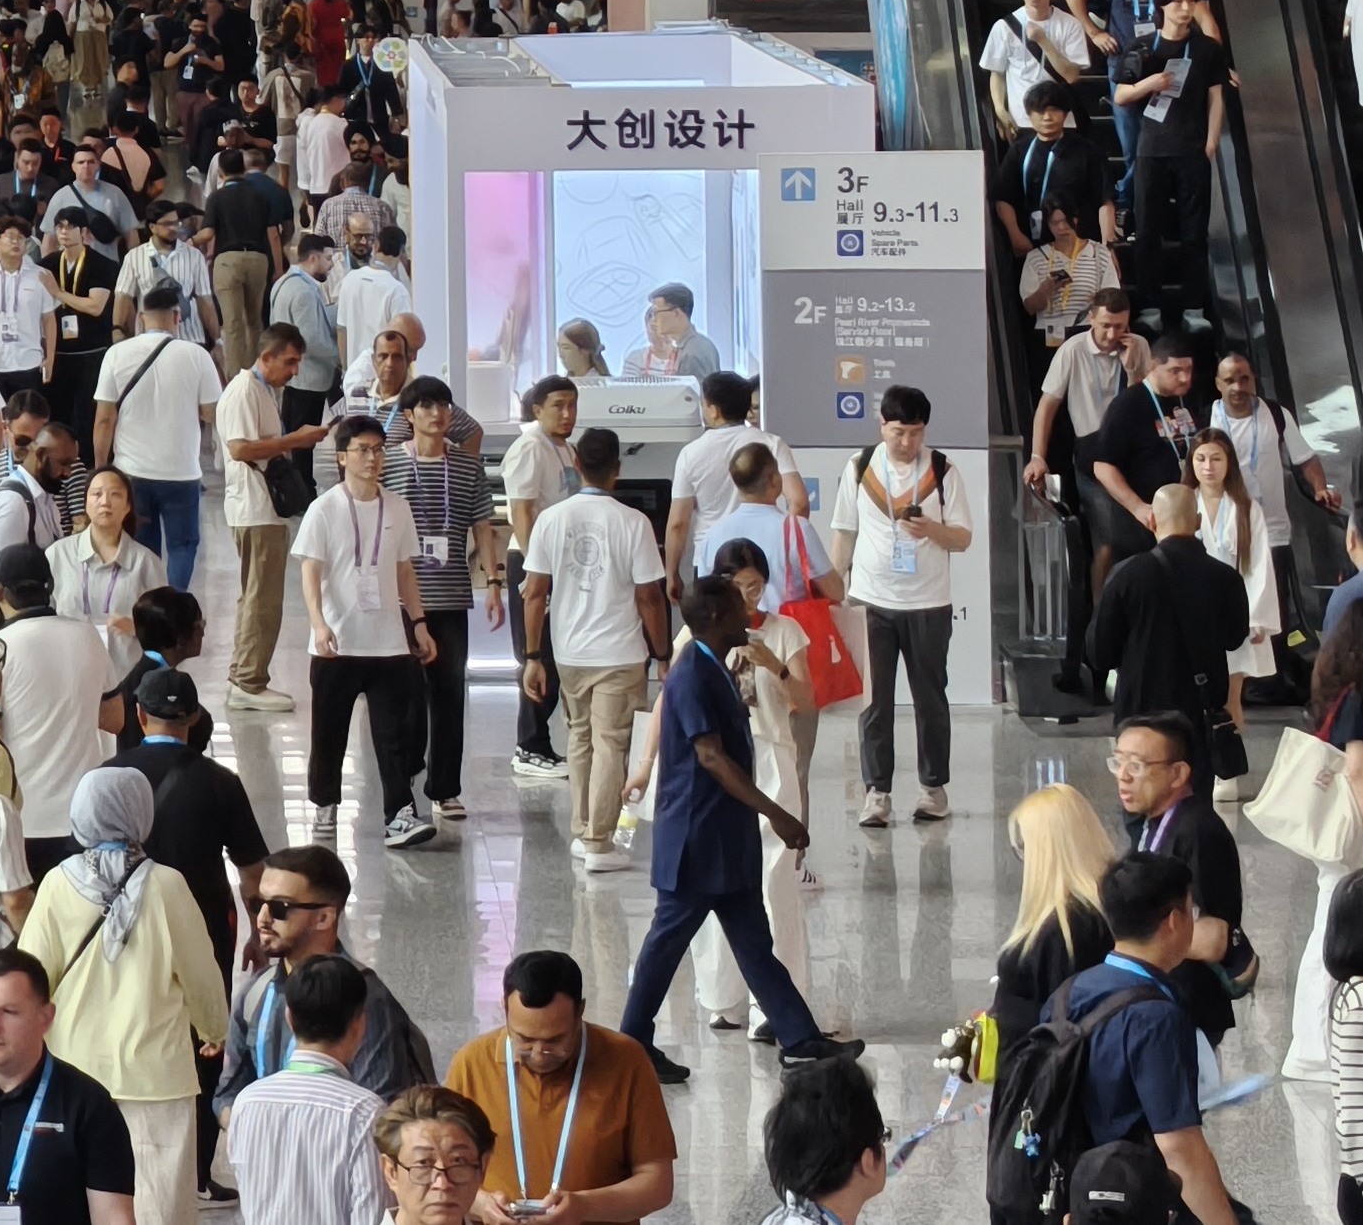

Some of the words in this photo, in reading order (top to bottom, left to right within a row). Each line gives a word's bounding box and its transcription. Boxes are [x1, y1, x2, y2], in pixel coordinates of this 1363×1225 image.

[566, 108, 756, 150] 大创设计
[837, 167, 869, 193] 3F
[837, 199, 863, 211] Hall
[874, 201, 959, 223] 9.3-11.3
[837, 212, 863, 224] 展厅
[794, 297, 827, 324] 2F
[857, 297, 915, 312] 9.2-13.2
[608, 404, 646, 414] Colku
